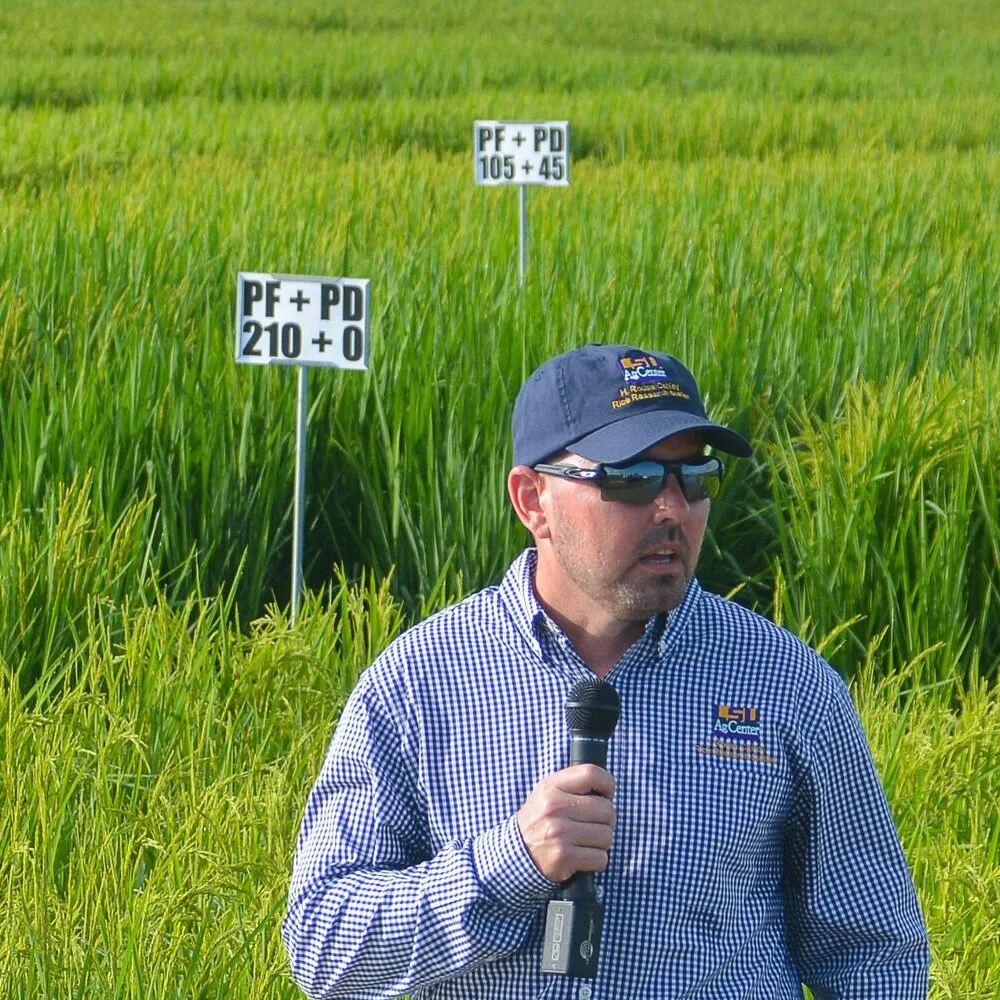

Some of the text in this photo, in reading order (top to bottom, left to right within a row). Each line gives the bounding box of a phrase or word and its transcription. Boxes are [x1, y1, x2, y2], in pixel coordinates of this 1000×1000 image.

[479, 126, 564, 152] PF + PD
[479, 155, 565, 181] 105 + 45
[243, 279, 364, 322] PF + PD
[242, 320, 364, 362] 210 + 0
[611, 398, 631, 409] Rice
[713, 719, 760, 735] AgCenter
